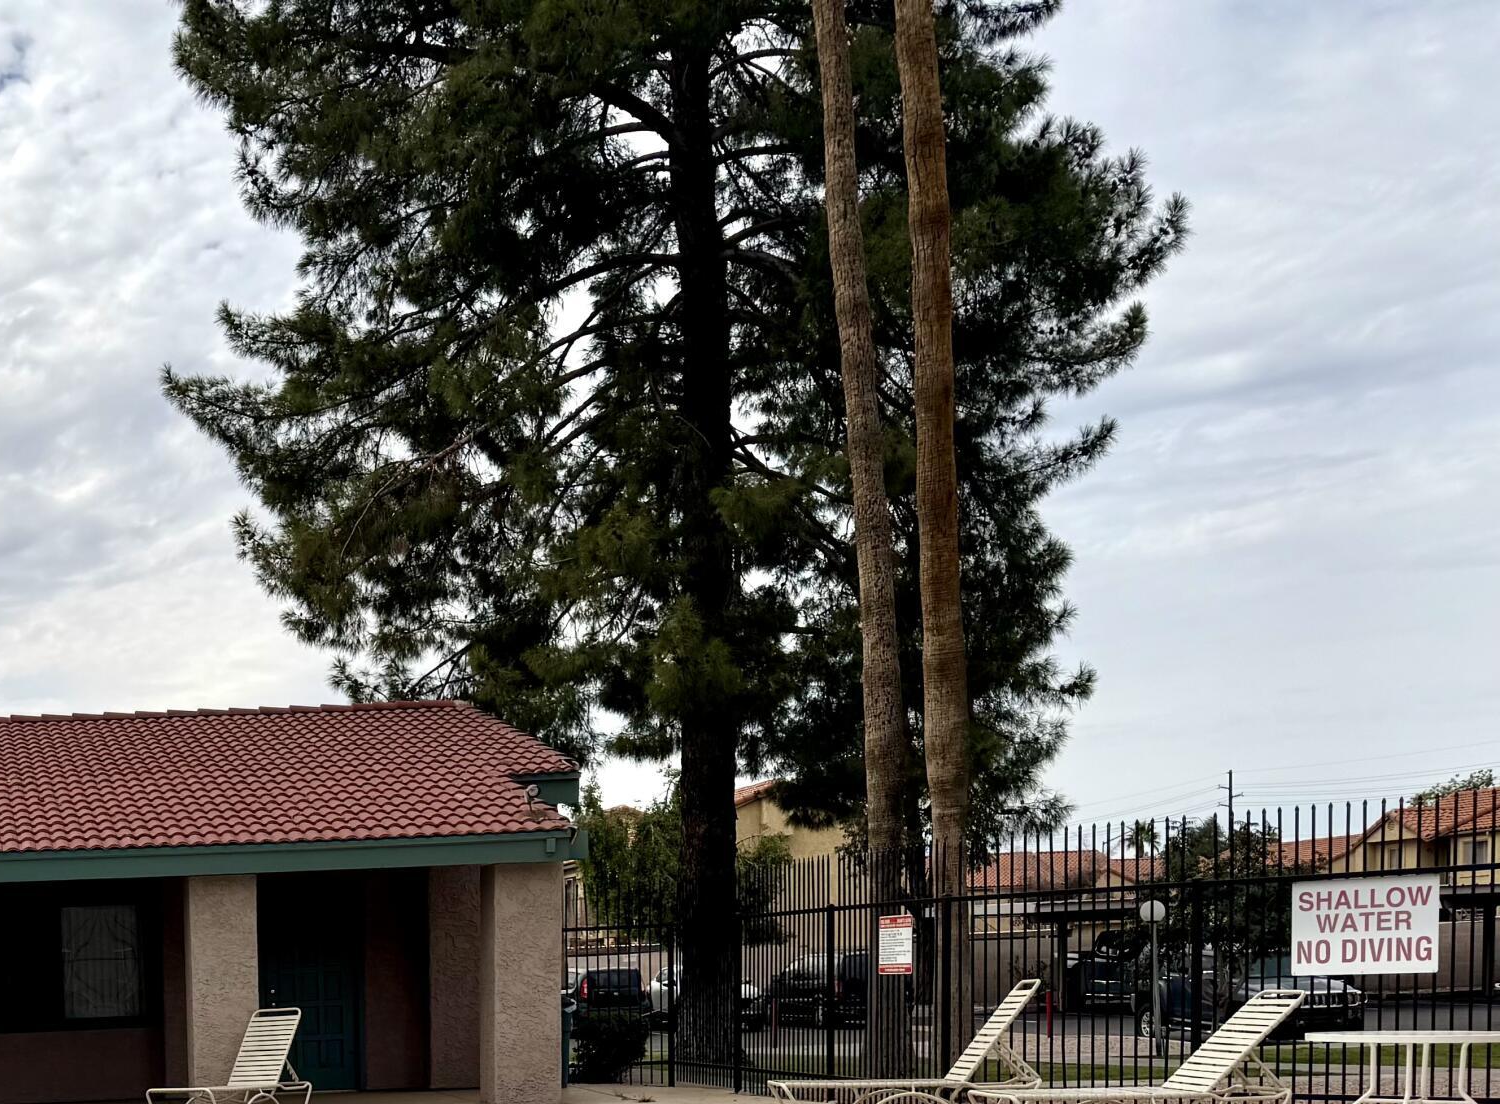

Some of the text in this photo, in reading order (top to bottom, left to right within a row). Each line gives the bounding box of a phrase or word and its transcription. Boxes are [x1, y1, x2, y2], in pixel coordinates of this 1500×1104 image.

[1298, 885, 1433, 912] SHALLOW
[1316, 910, 1412, 933] WATER
[1296, 936, 1433, 964] NO DIVING
